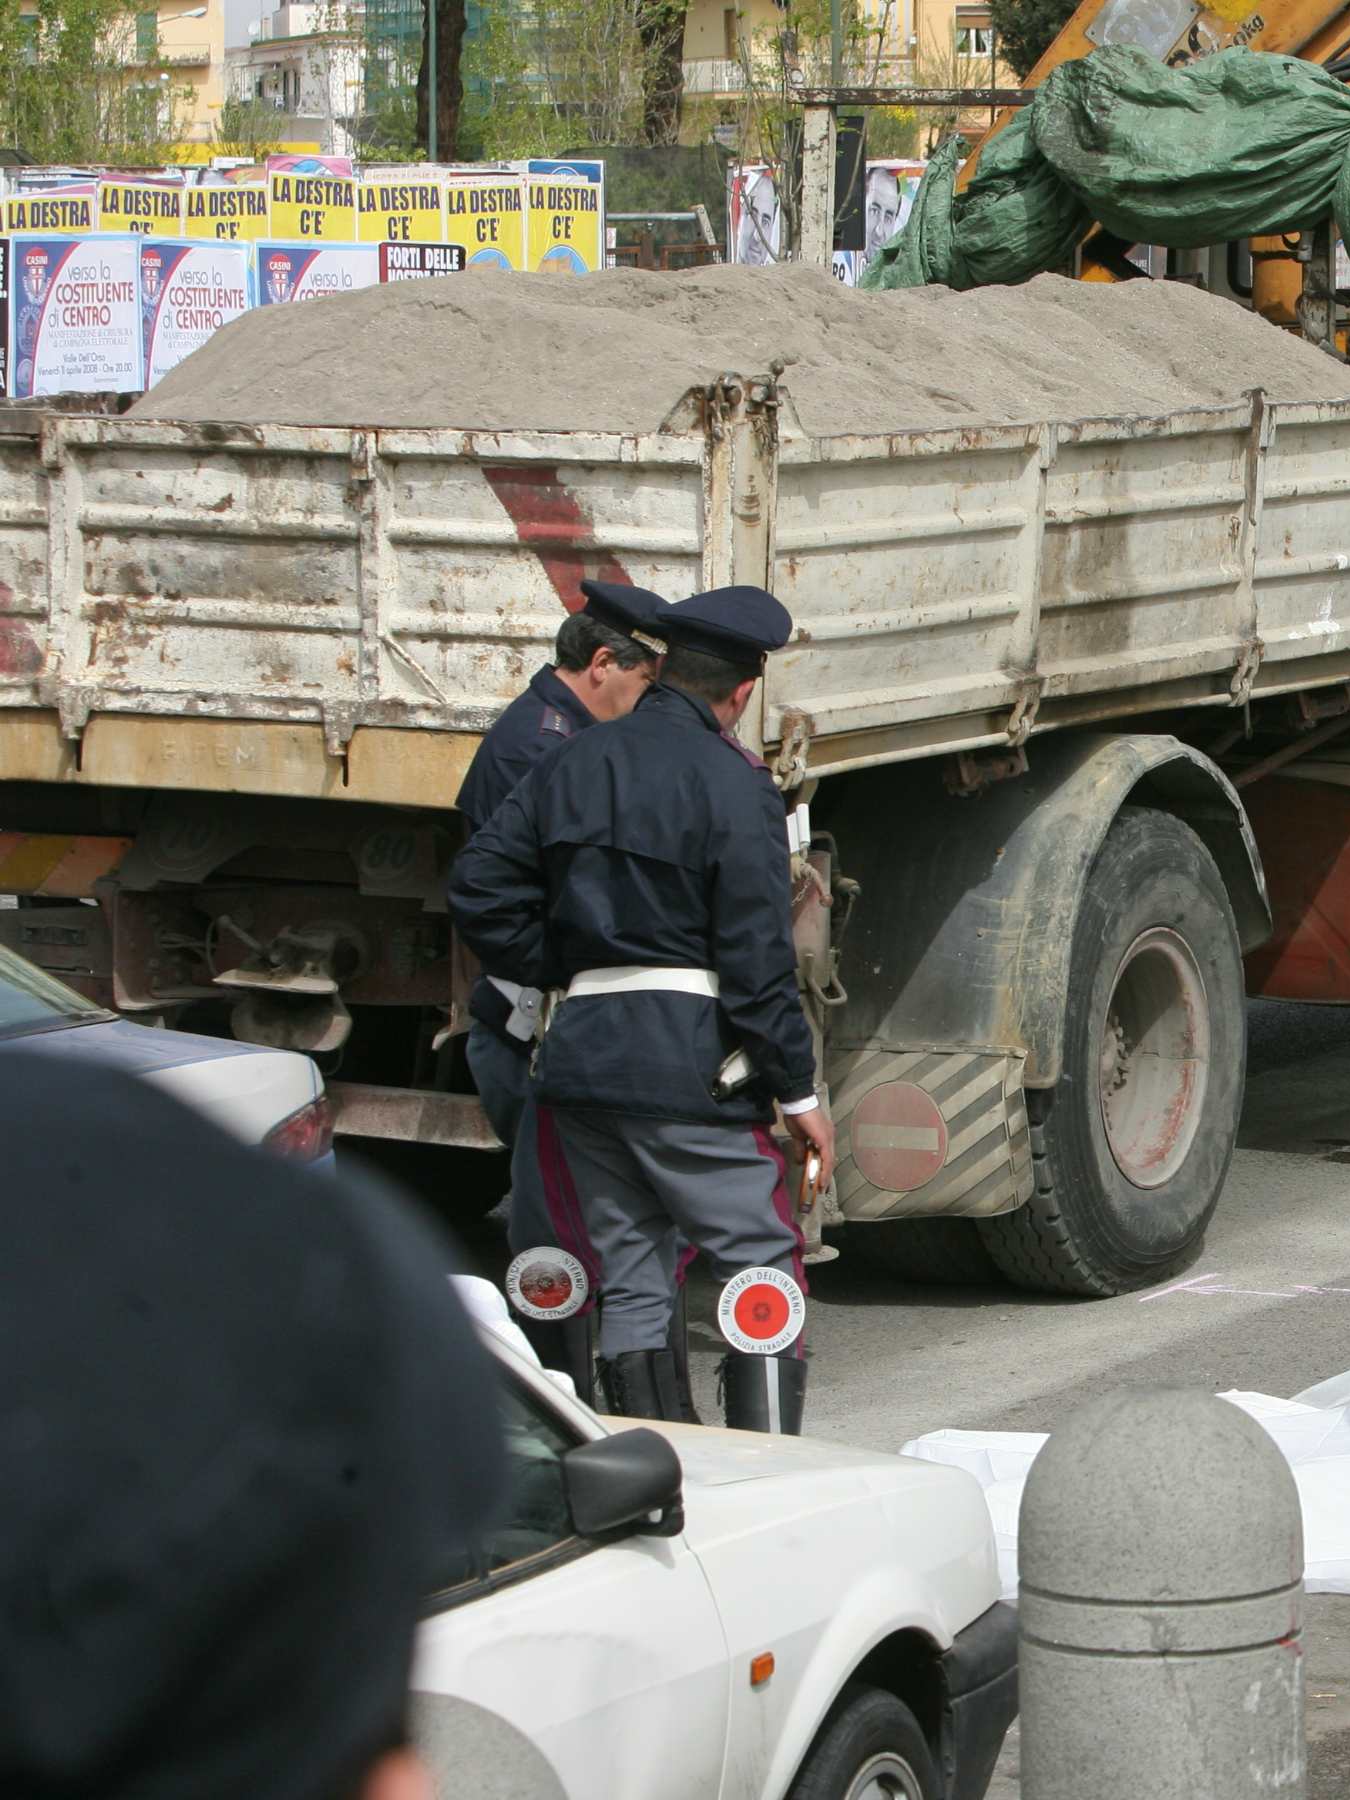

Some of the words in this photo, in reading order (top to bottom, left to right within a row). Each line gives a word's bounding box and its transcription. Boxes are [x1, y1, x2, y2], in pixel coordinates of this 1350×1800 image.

[102, 187, 120, 214] LA
[124, 189, 180, 218] DESTRA
[188, 191, 206, 217] LA
[209, 191, 267, 217] DESTRA
[272, 177, 291, 203] LA
[295, 179, 354, 207] DESTRA
[358, 188, 377, 212] LA
[380, 186, 441, 212] DESTRA
[449, 191, 467, 214] LA
[470, 188, 522, 214] DESTRA
[530, 186, 545, 209] LA
[548, 187, 598, 211] DESTRA
[8, 202, 27, 229] LA
[31, 201, 91, 228] DESTRA
[300, 209, 326, 235] C'E'
[552, 215, 575, 239] C'E'
[388, 216, 413, 240] C'E'
[477, 218, 500, 243] C'E'
[26, 255, 48, 265] CASINI
[269, 261, 292, 271] CASINI
[387, 246, 421, 269] FORTI
[425, 248, 460, 270] DELLE
[67, 265, 97, 281] verso
[100, 260, 111, 281] la
[180, 271, 208, 286] verso
[212, 265, 223, 286] la
[310, 272, 338, 288] verso
[342, 267, 353, 288] la
[56, 282, 134, 304] COSTITUENTE
[169, 287, 245, 309] COSTITUENTE
[48, 308, 60, 328] di
[62, 305, 111, 327] CENTRO
[163, 308, 173, 329] di
[176, 309, 224, 330] CENTRO
[721, 1273, 753, 1316] MINISTERO
[730, 1331, 755, 1352] POLIZIA
[758, 1332, 792, 1352] STRADALE
